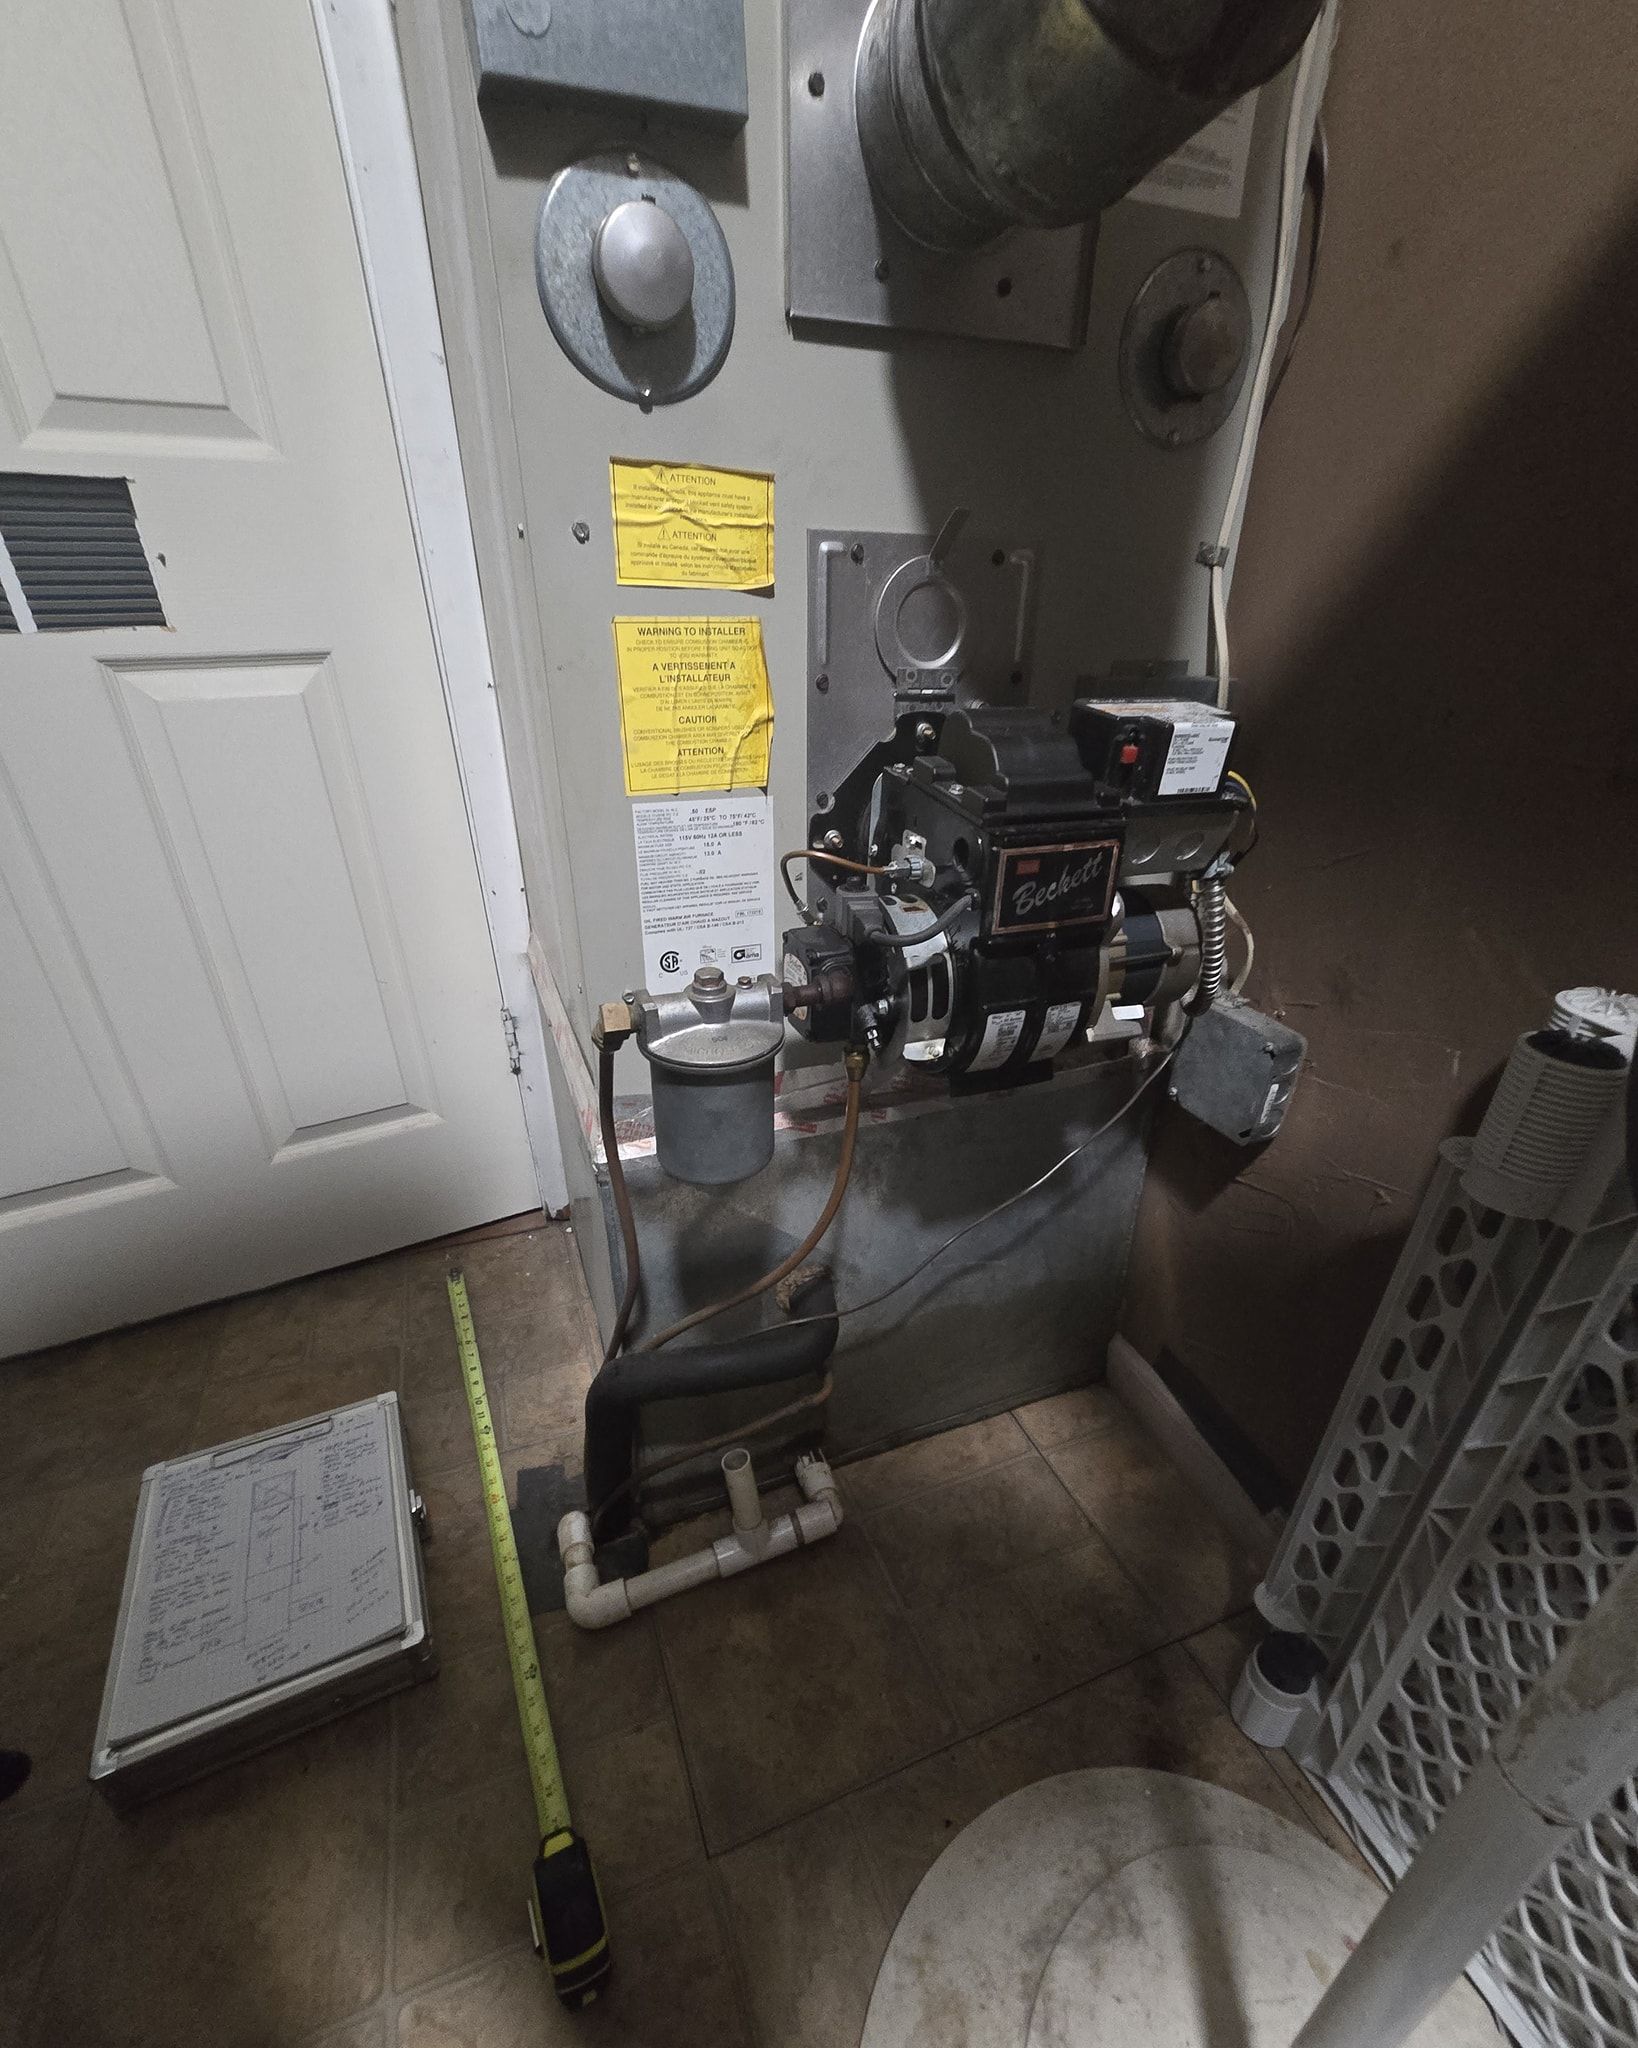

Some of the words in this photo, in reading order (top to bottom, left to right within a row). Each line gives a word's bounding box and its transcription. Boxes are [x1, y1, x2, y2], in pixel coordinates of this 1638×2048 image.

[669, 473, 717, 486] ATTENTION
[672, 530, 717, 542] ATTENTION
[637, 626, 682, 637] WARNING
[684, 627, 697, 637] TO
[698, 627, 746, 637] INSTALLER
[652, 662, 659, 672] A
[729, 662, 736, 671] A
[659, 673, 731, 683] L'INSTALLATEUR
[678, 715, 717, 725] CAUTION
[677, 747, 725, 758] ATTENTION
[728, 830, 743, 838] LESS
[1012, 851, 1104, 915] Beckett
[659, 950, 680, 974] CSA
[474, 1395, 483, 1405] 10
[477, 1411, 485, 1419] 11
